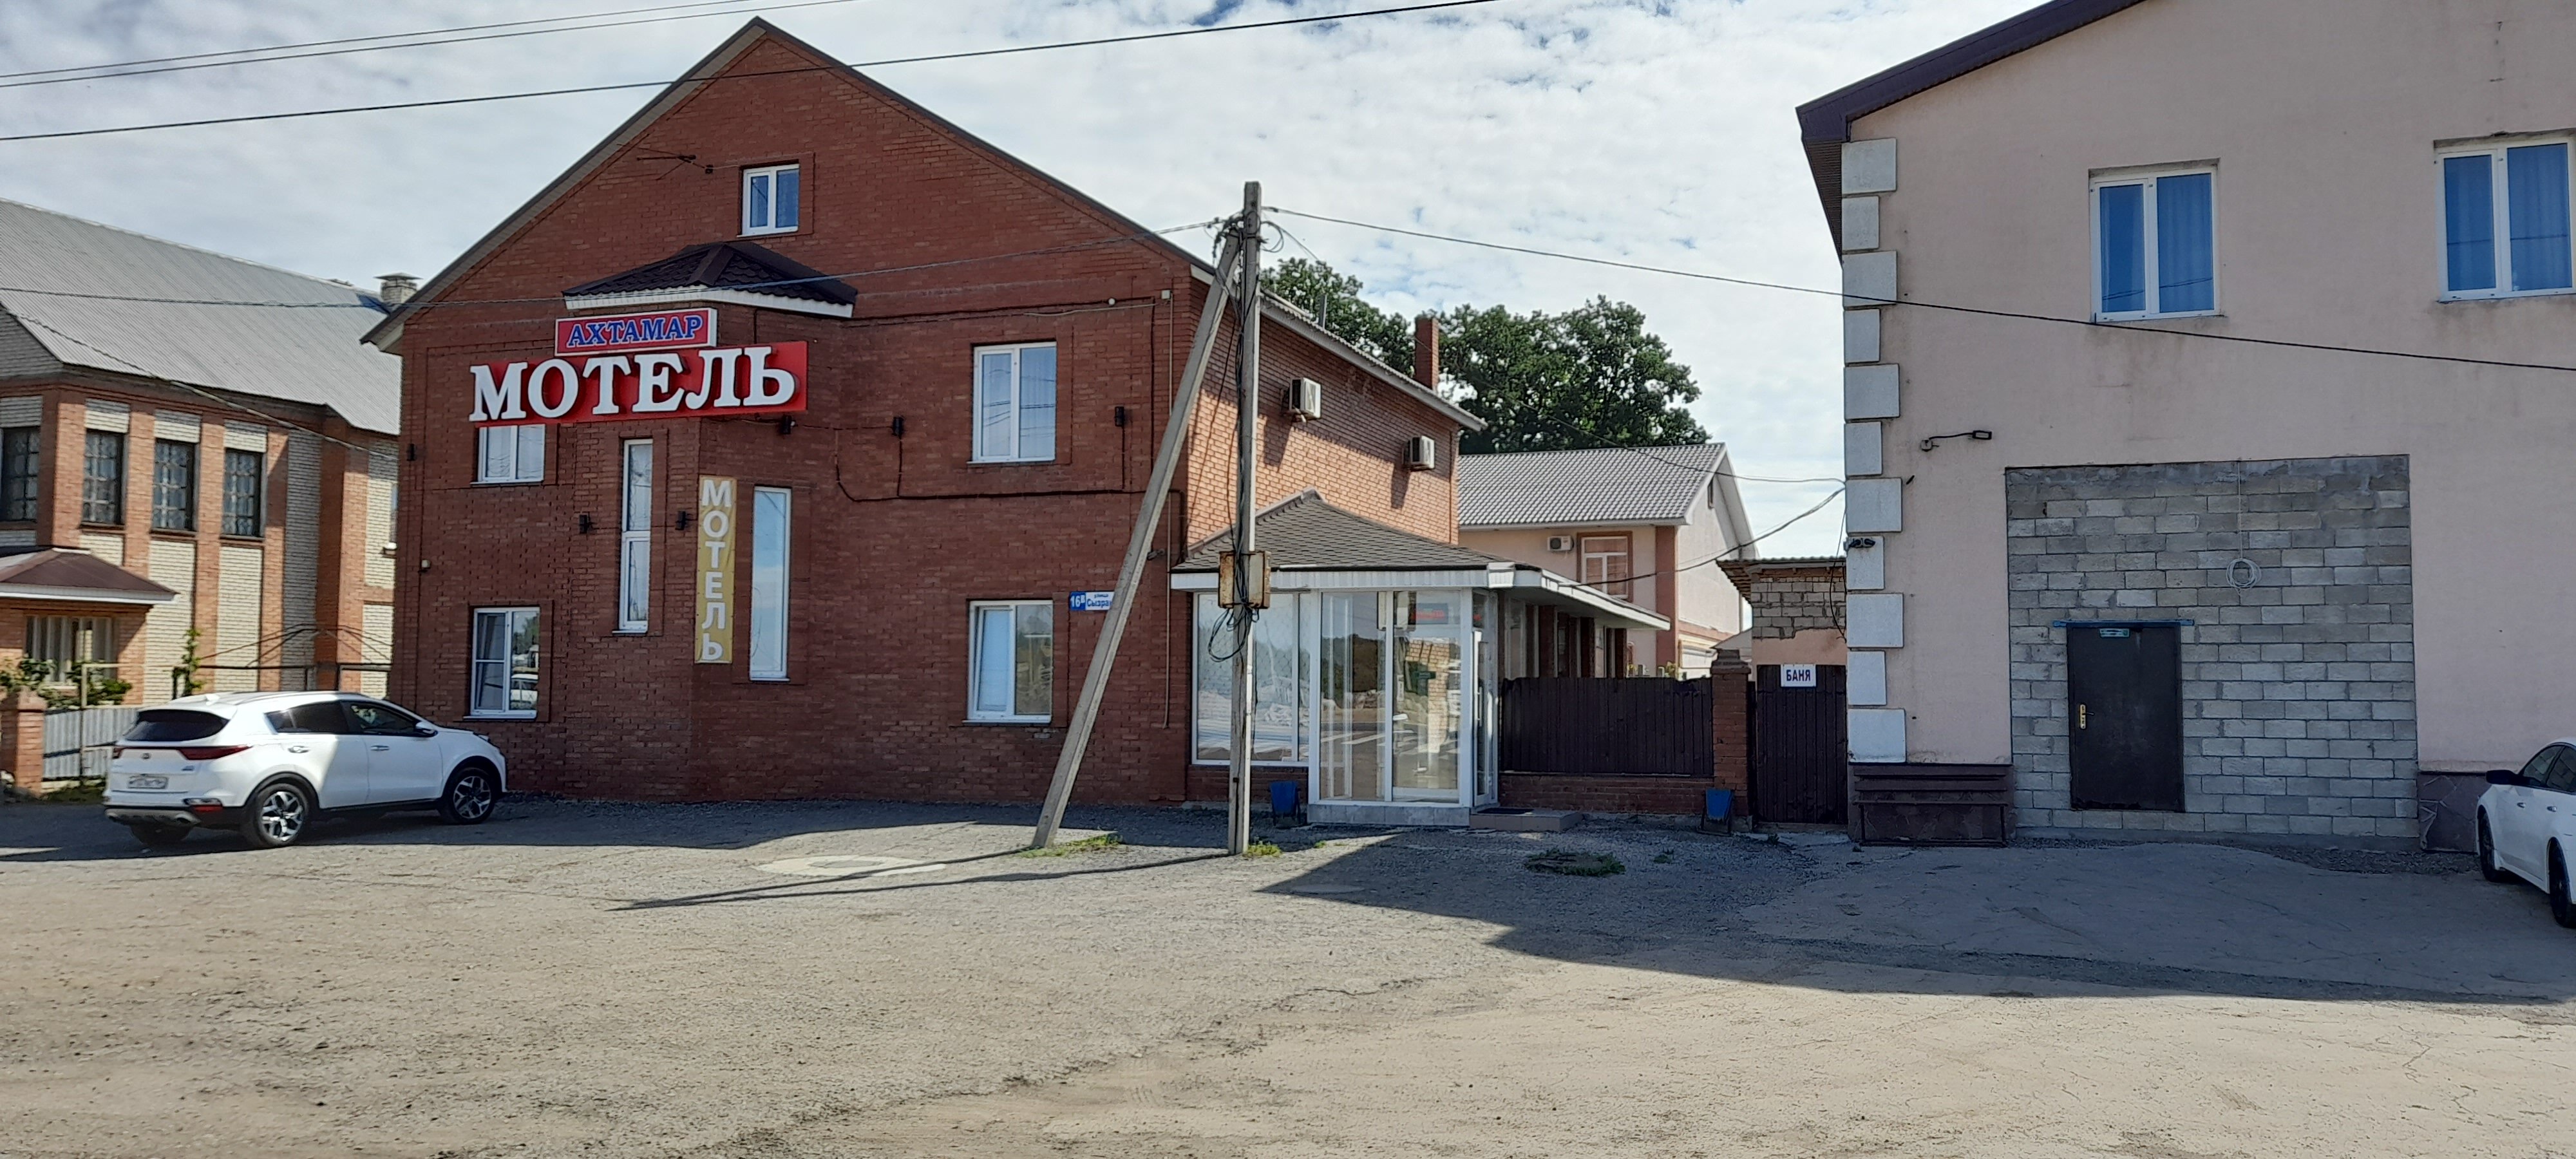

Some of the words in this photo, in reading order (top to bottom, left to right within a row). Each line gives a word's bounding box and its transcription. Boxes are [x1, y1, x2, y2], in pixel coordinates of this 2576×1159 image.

[567, 315, 703, 347] АХТАМАР
[469, 346, 795, 421] МОТЕЛЬ
[701, 480, 732, 661] МОТЕЛЬ
[1786, 669, 1811, 681] БАНЯ
